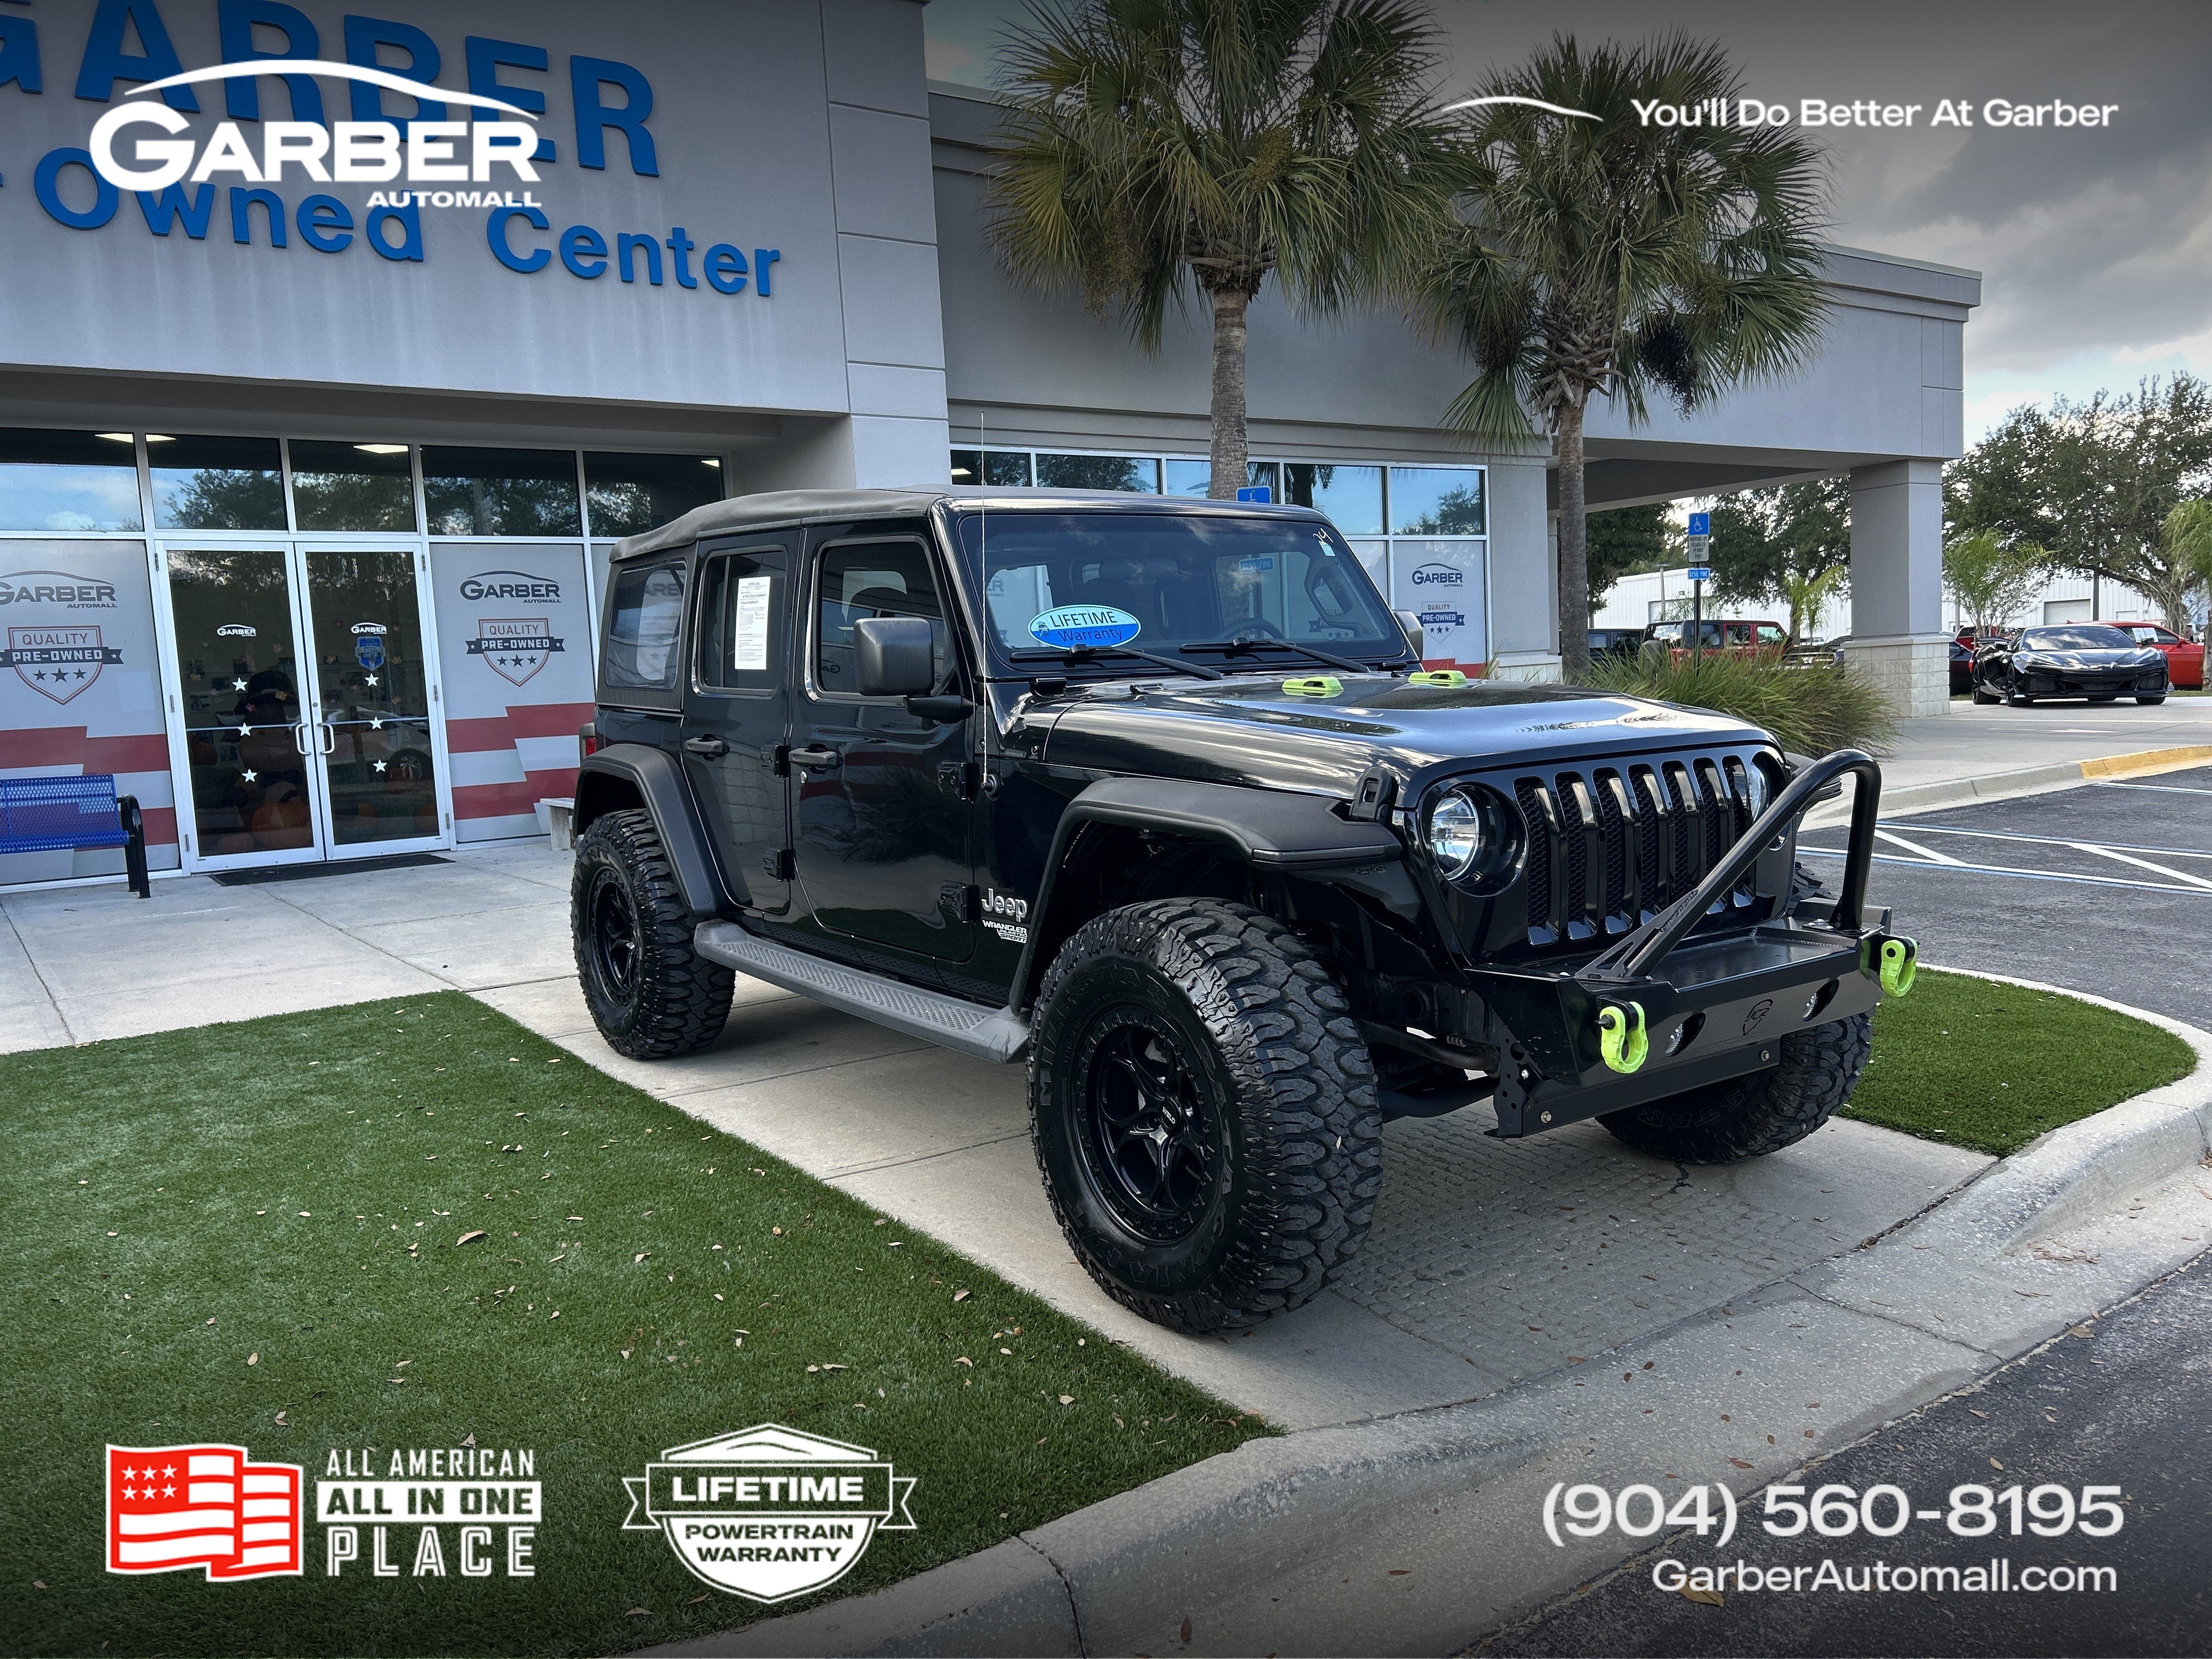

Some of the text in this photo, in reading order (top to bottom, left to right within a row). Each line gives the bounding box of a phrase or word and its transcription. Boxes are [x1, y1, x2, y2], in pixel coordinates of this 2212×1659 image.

[0, 146, 781, 297] Owned Center
[1412, 570, 1463, 585] GARBER
[460, 580, 561, 601] GARBER
[1050, 611, 1118, 628] LIFETIME
[1422, 613, 1457, 622] PRE-OWNED
[489, 624, 539, 635] QUALITY
[1056, 627, 1122, 642] Warranty
[22, 633, 88, 646] QUALITY
[481, 639, 550, 650] PRE-OWNED
[12, 650, 103, 662] PRE-OWNED
[981, 888, 1028, 923] Jeep
[981, 919, 1027, 934] WRANGLER
[999, 933, 1027, 943] SPORT
[1040, 963, 1170, 1107] MILESTAR
[1162, 1106, 1176, 1125] WELD
